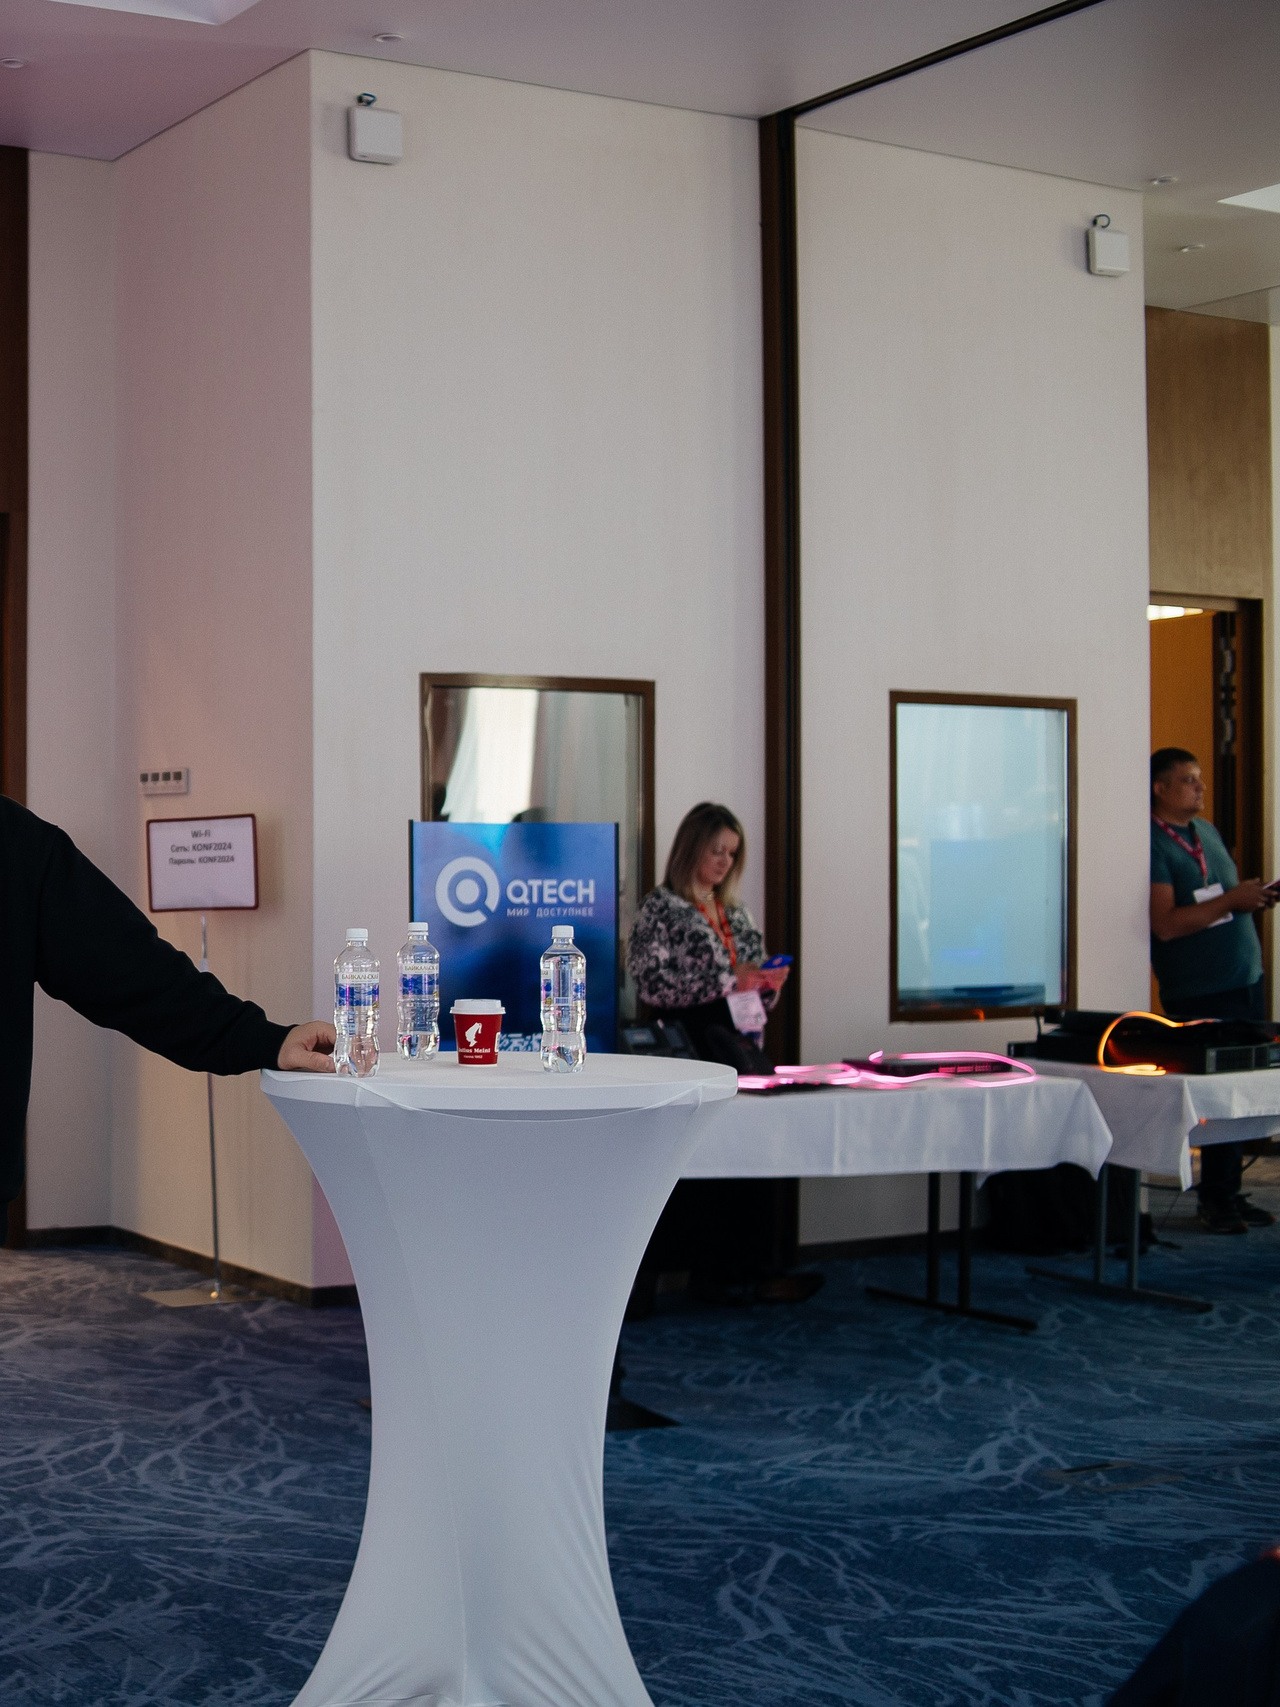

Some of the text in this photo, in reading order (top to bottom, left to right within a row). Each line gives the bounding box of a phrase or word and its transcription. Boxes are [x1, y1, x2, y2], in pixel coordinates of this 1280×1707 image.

[190, 829, 211, 838] Wi-Fi
[192, 842, 232, 852] KONF2024
[198, 855, 235, 864] KONF2024
[506, 878, 595, 905] QTECH
[506, 906, 595, 918] МИР ДОСТУПНЕЕ
